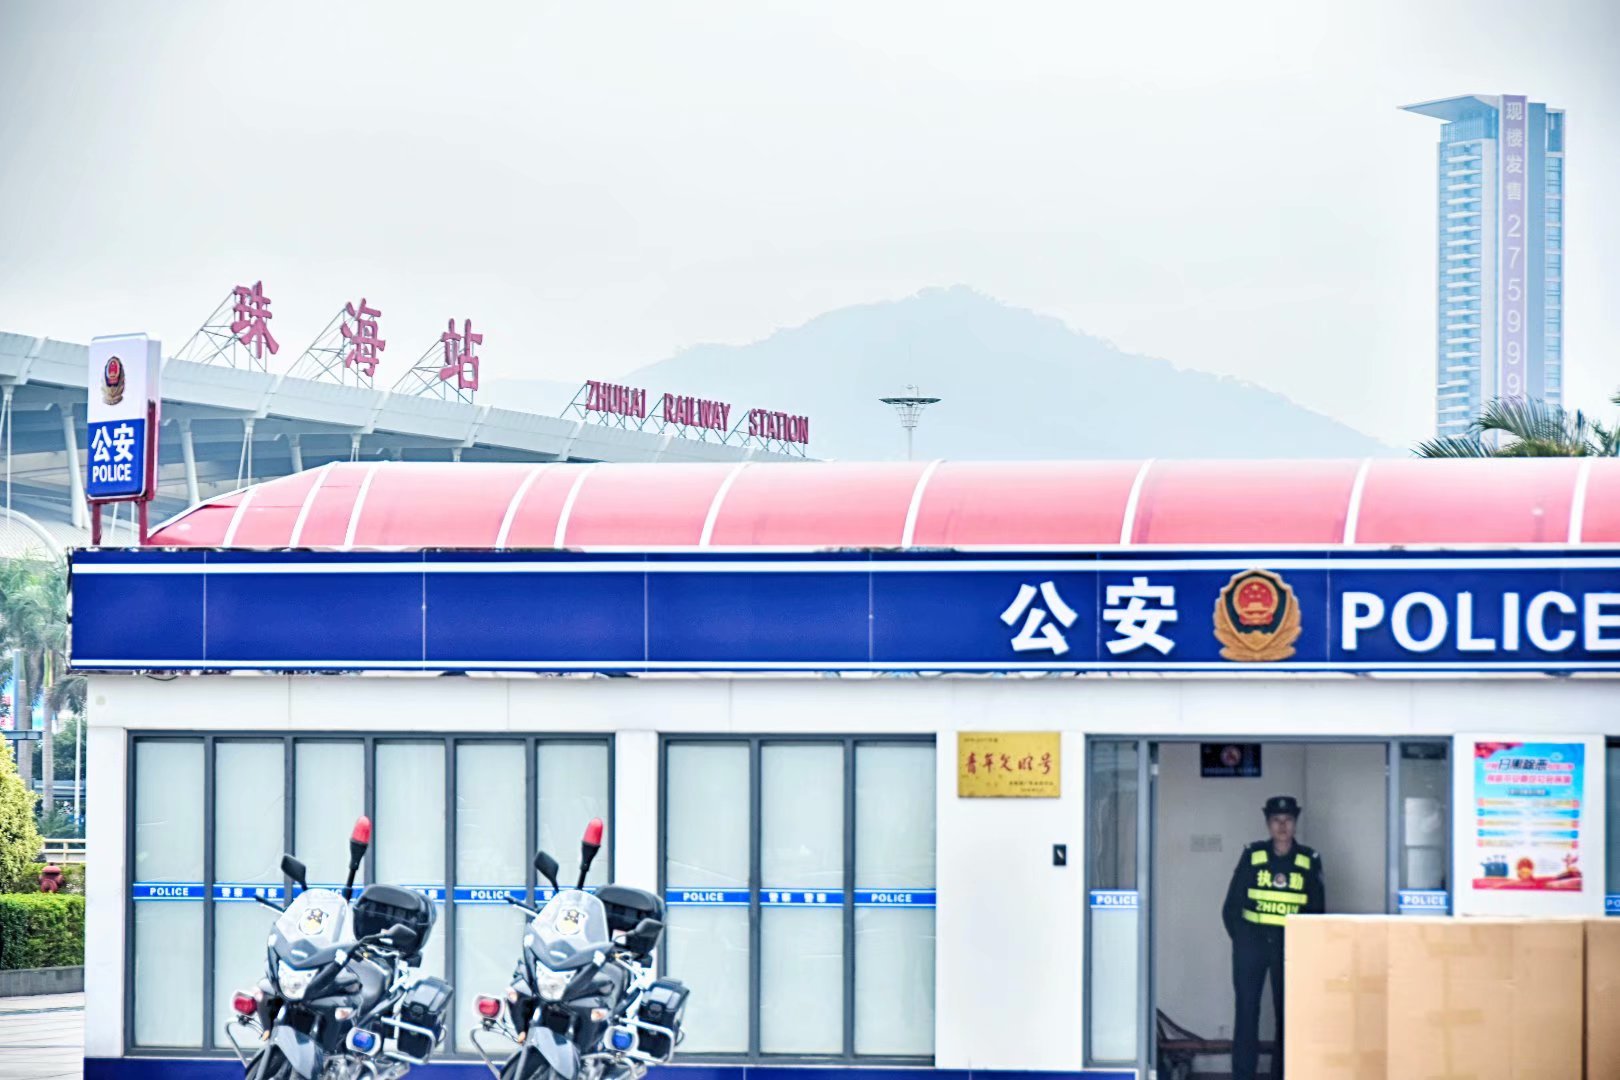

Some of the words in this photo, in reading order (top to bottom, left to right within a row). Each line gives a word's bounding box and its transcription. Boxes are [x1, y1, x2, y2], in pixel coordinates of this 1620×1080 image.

[231, 281, 483, 391] 珠海站
[585, 380, 646, 418] ZHUHAI
[663, 393, 731, 431] RAILWAY
[749, 408, 809, 444] STATION
[91, 423, 135, 462] 公安
[92, 464, 132, 482] POLICE
[1000, 577, 1178, 655] 公安
[1341, 592, 1620, 651] POLICE
[1257, 869, 1304, 890] 执勤
[150, 887, 189, 896] POLICE
[683, 892, 724, 901] POLICE
[871, 893, 912, 903] POLICE
[1096, 895, 1138, 905] POLICE
